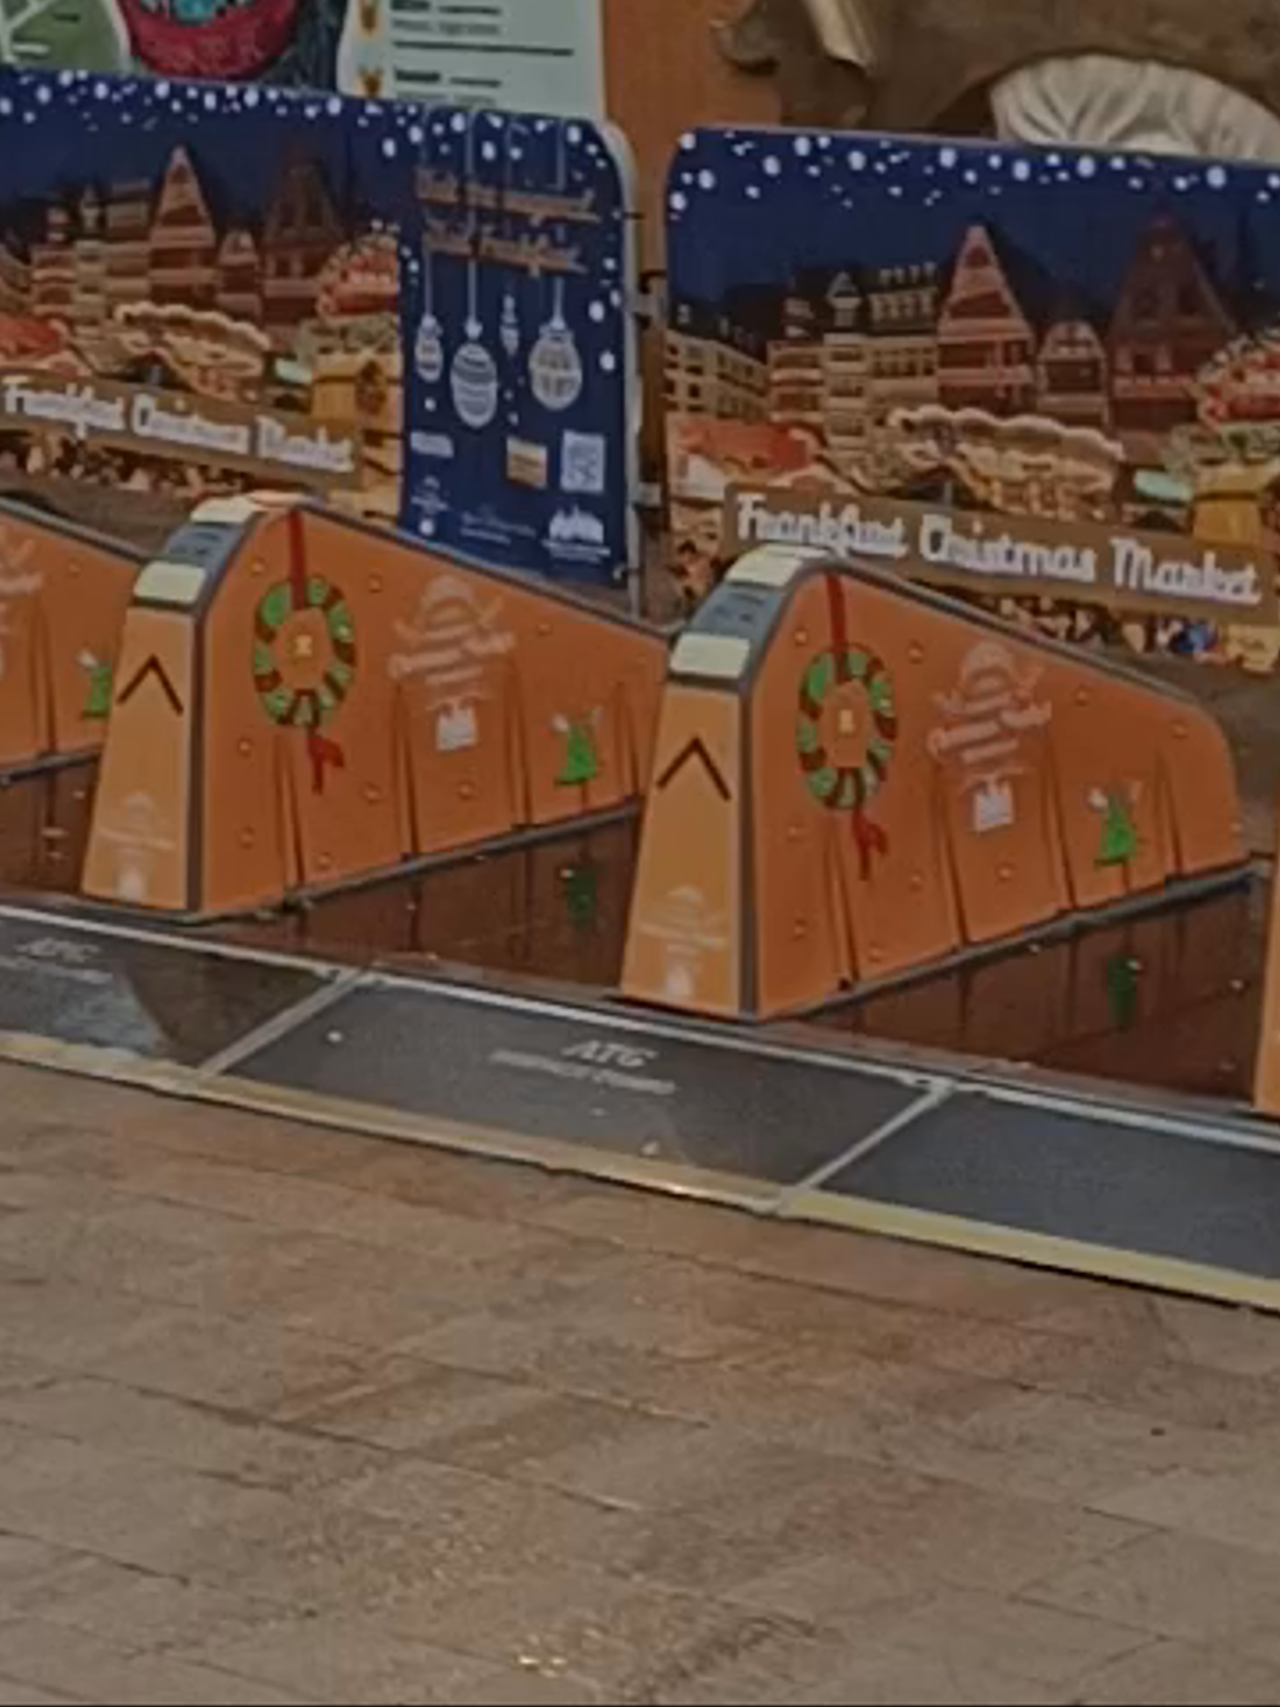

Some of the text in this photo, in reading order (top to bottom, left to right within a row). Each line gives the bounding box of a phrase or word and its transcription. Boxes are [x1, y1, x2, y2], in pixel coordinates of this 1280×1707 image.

[736, 492, 1262, 606] Frankfurt Christmas Market
